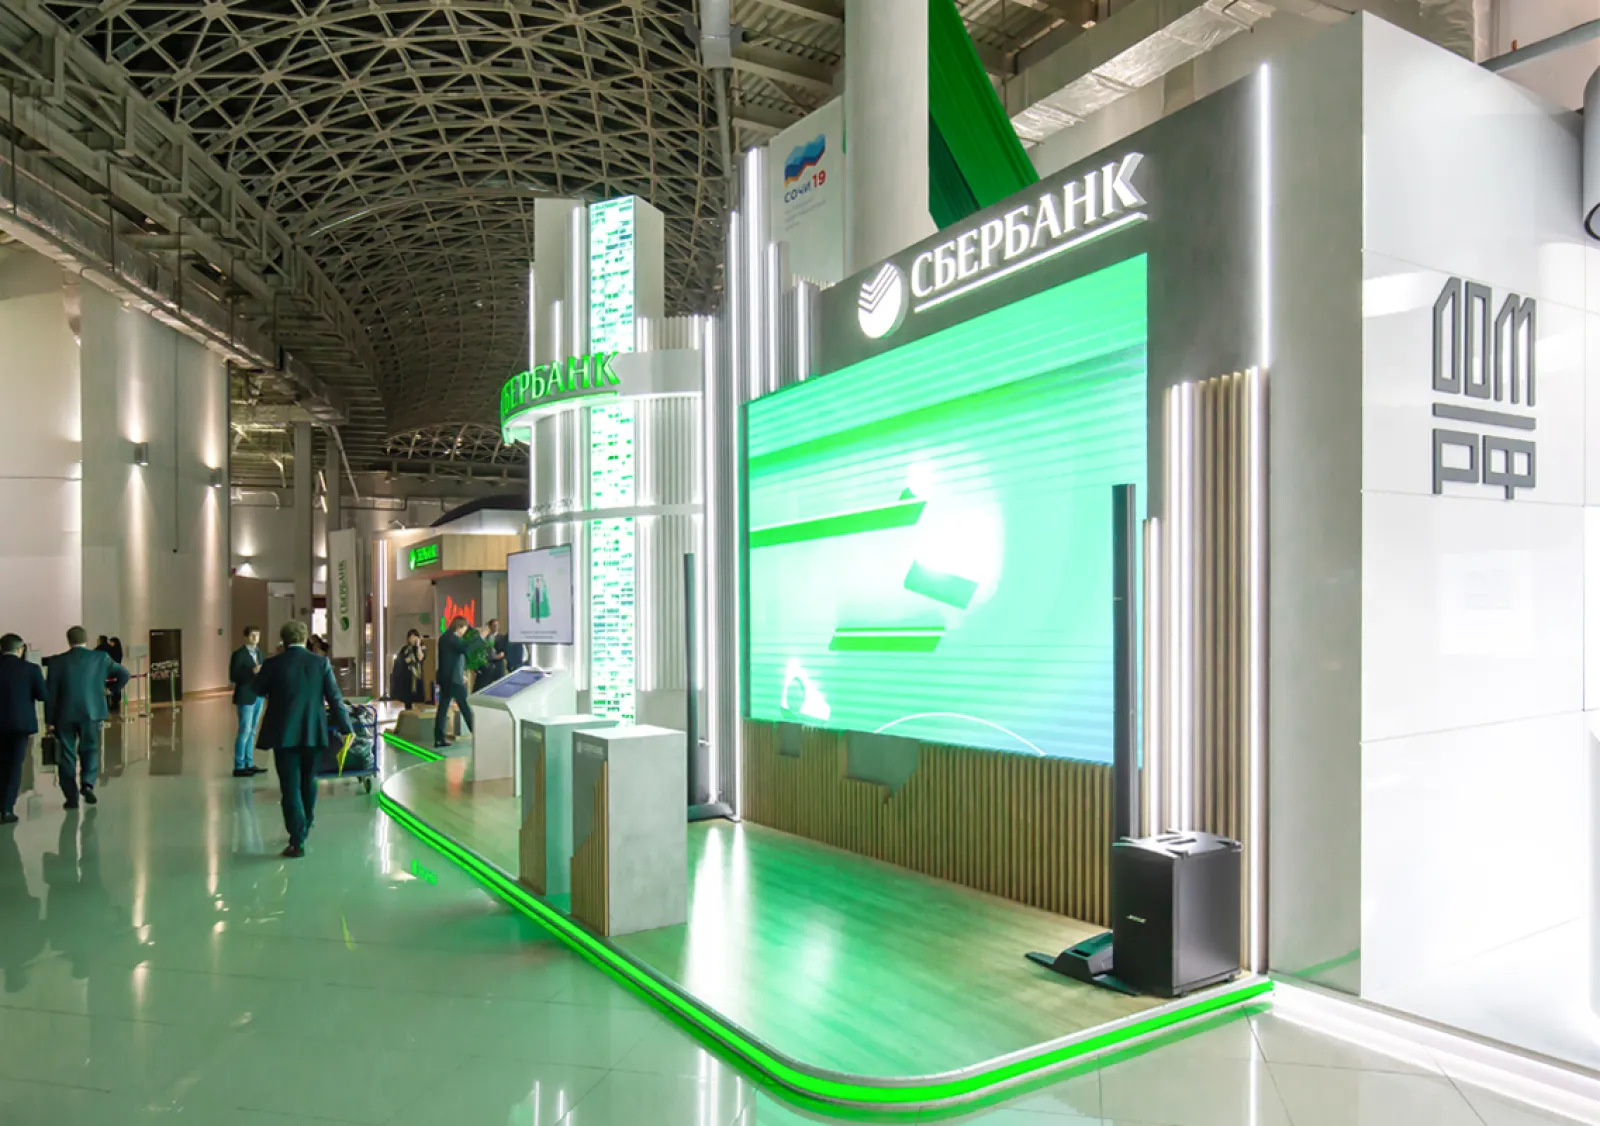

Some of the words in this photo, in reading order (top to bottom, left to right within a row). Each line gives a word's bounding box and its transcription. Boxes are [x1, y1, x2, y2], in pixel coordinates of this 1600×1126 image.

[812, 169, 827, 188] 19
[911, 152, 1147, 298] СБЕРБАНК
[1432, 276, 1537, 407] ДОМ
[1432, 428, 1536, 501] РФ
